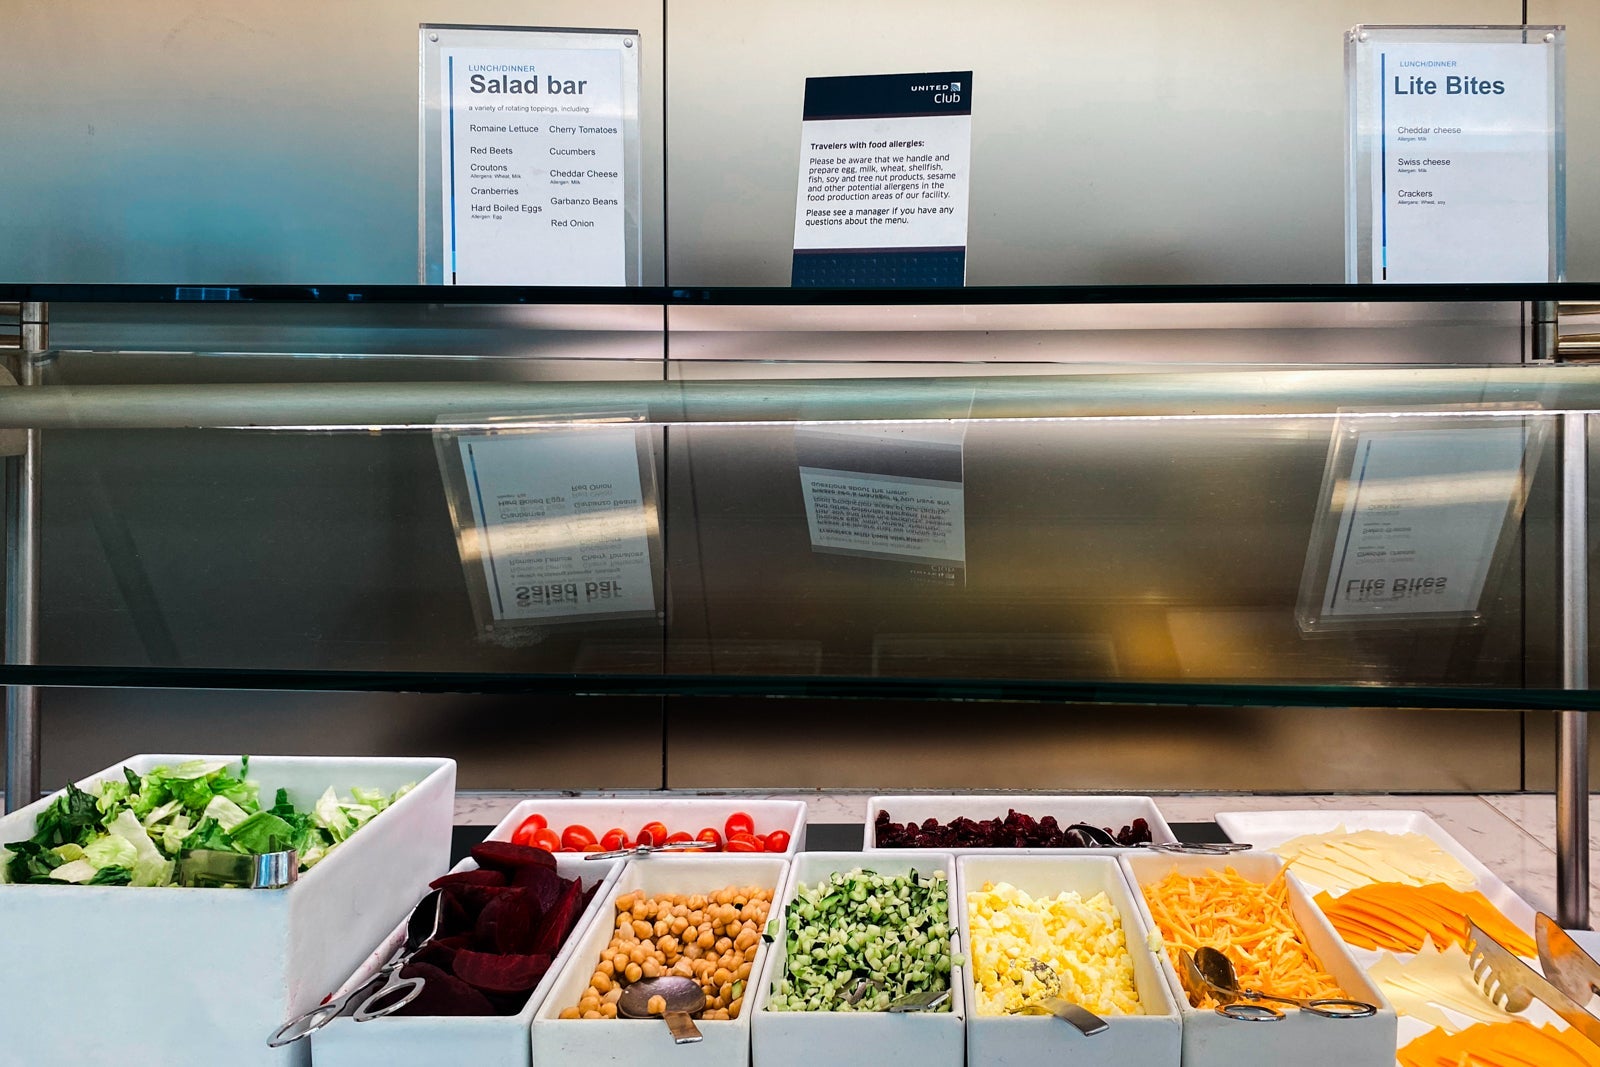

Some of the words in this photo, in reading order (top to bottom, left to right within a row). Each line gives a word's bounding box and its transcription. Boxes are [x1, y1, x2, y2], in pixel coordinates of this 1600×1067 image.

[470, 74, 538, 93] Salad
[547, 76, 587, 94] bar
[1395, 76, 1437, 95] Lite
[1446, 76, 1505, 95] Bites
[934, 93, 960, 103] Club
[509, 125, 539, 133] Lettuce
[549, 126, 576, 135] Cherry
[889, 140, 925, 148] allergies:
[471, 187, 519, 195] Cranberries
[828, 193, 869, 201] production
[922, 191, 950, 199] facility.
[494, 204, 519, 212] Boiled
[522, 205, 542, 213] Eggs
[856, 208, 889, 216] manager
[806, 218, 842, 226] questions
